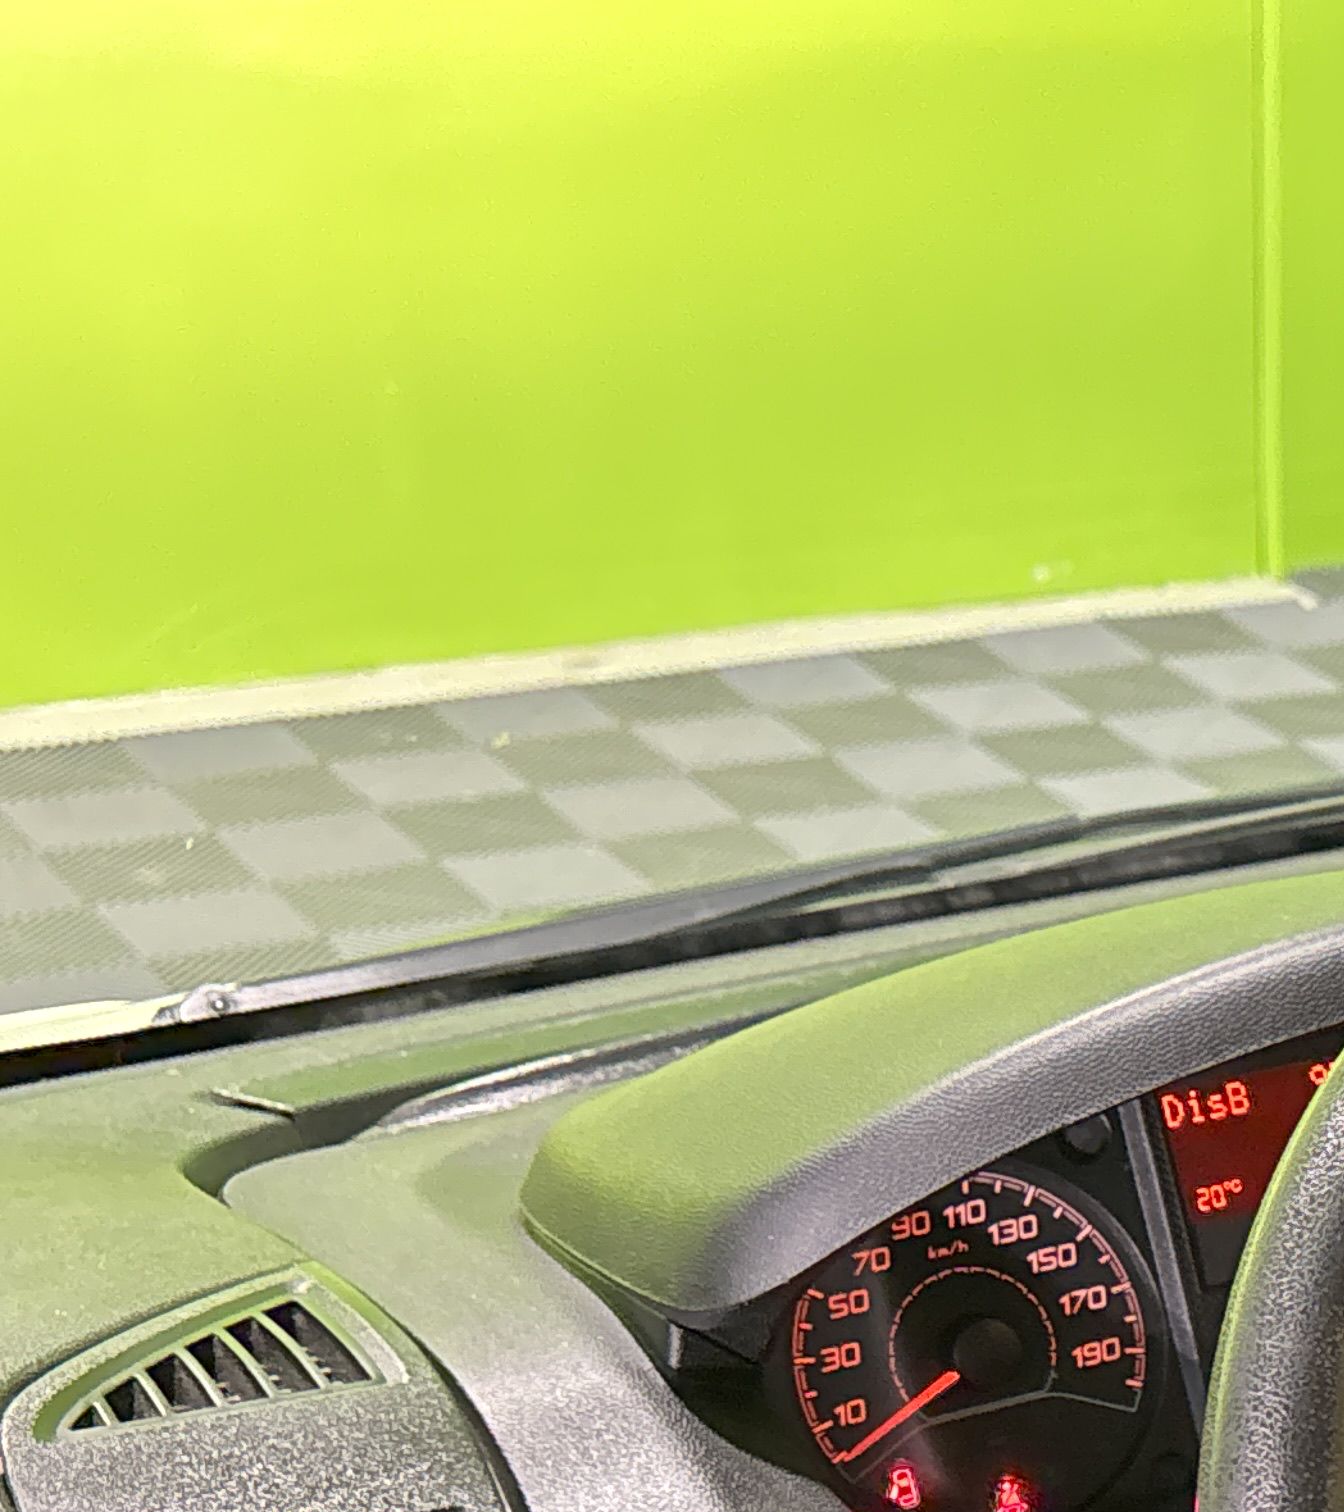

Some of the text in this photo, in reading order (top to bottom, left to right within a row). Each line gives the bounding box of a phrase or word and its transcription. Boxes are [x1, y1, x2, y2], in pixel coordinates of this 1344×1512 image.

[1161, 1078, 1251, 1129] DisB
[891, 1210, 931, 1241] 90
[943, 1198, 987, 1229] 110
[987, 1212, 1038, 1246] 130
[853, 1246, 892, 1276] 70
[1027, 1241, 1077, 1274] 150
[828, 1288, 869, 1319] 50
[1059, 1284, 1107, 1316] 170
[820, 1341, 861, 1373] 30
[1072, 1336, 1121, 1369] 190
[833, 1399, 867, 1427] 10
